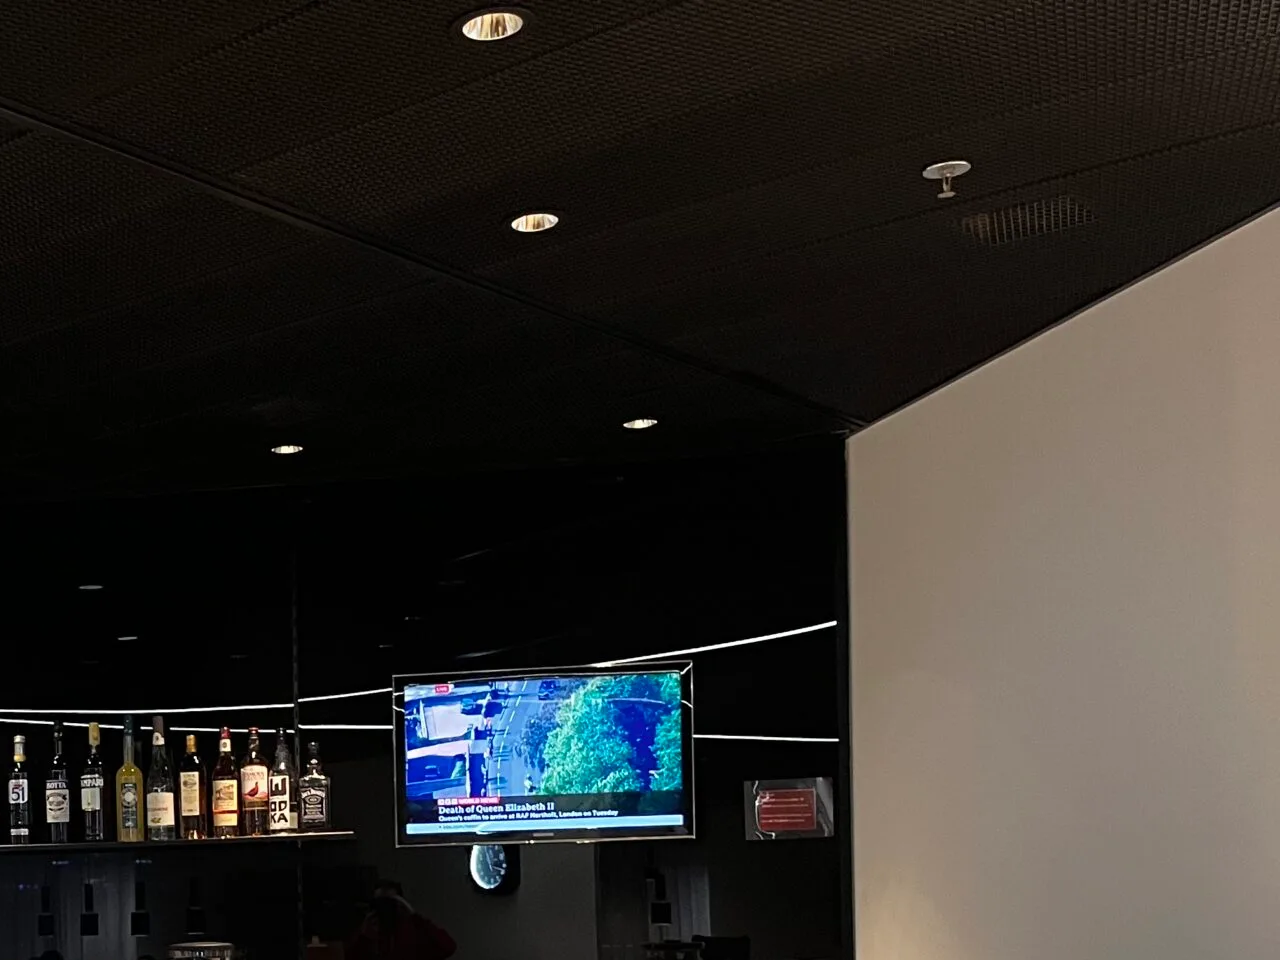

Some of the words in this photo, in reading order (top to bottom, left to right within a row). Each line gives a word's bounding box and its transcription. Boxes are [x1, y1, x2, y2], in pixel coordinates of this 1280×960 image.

[11, 787, 25, 801] 51
[438, 806, 464, 814] Death
[465, 805, 475, 813] of
[476, 804, 504, 814] Queen
[505, 803, 546, 811] Elizabeth
[547, 802, 555, 810] II
